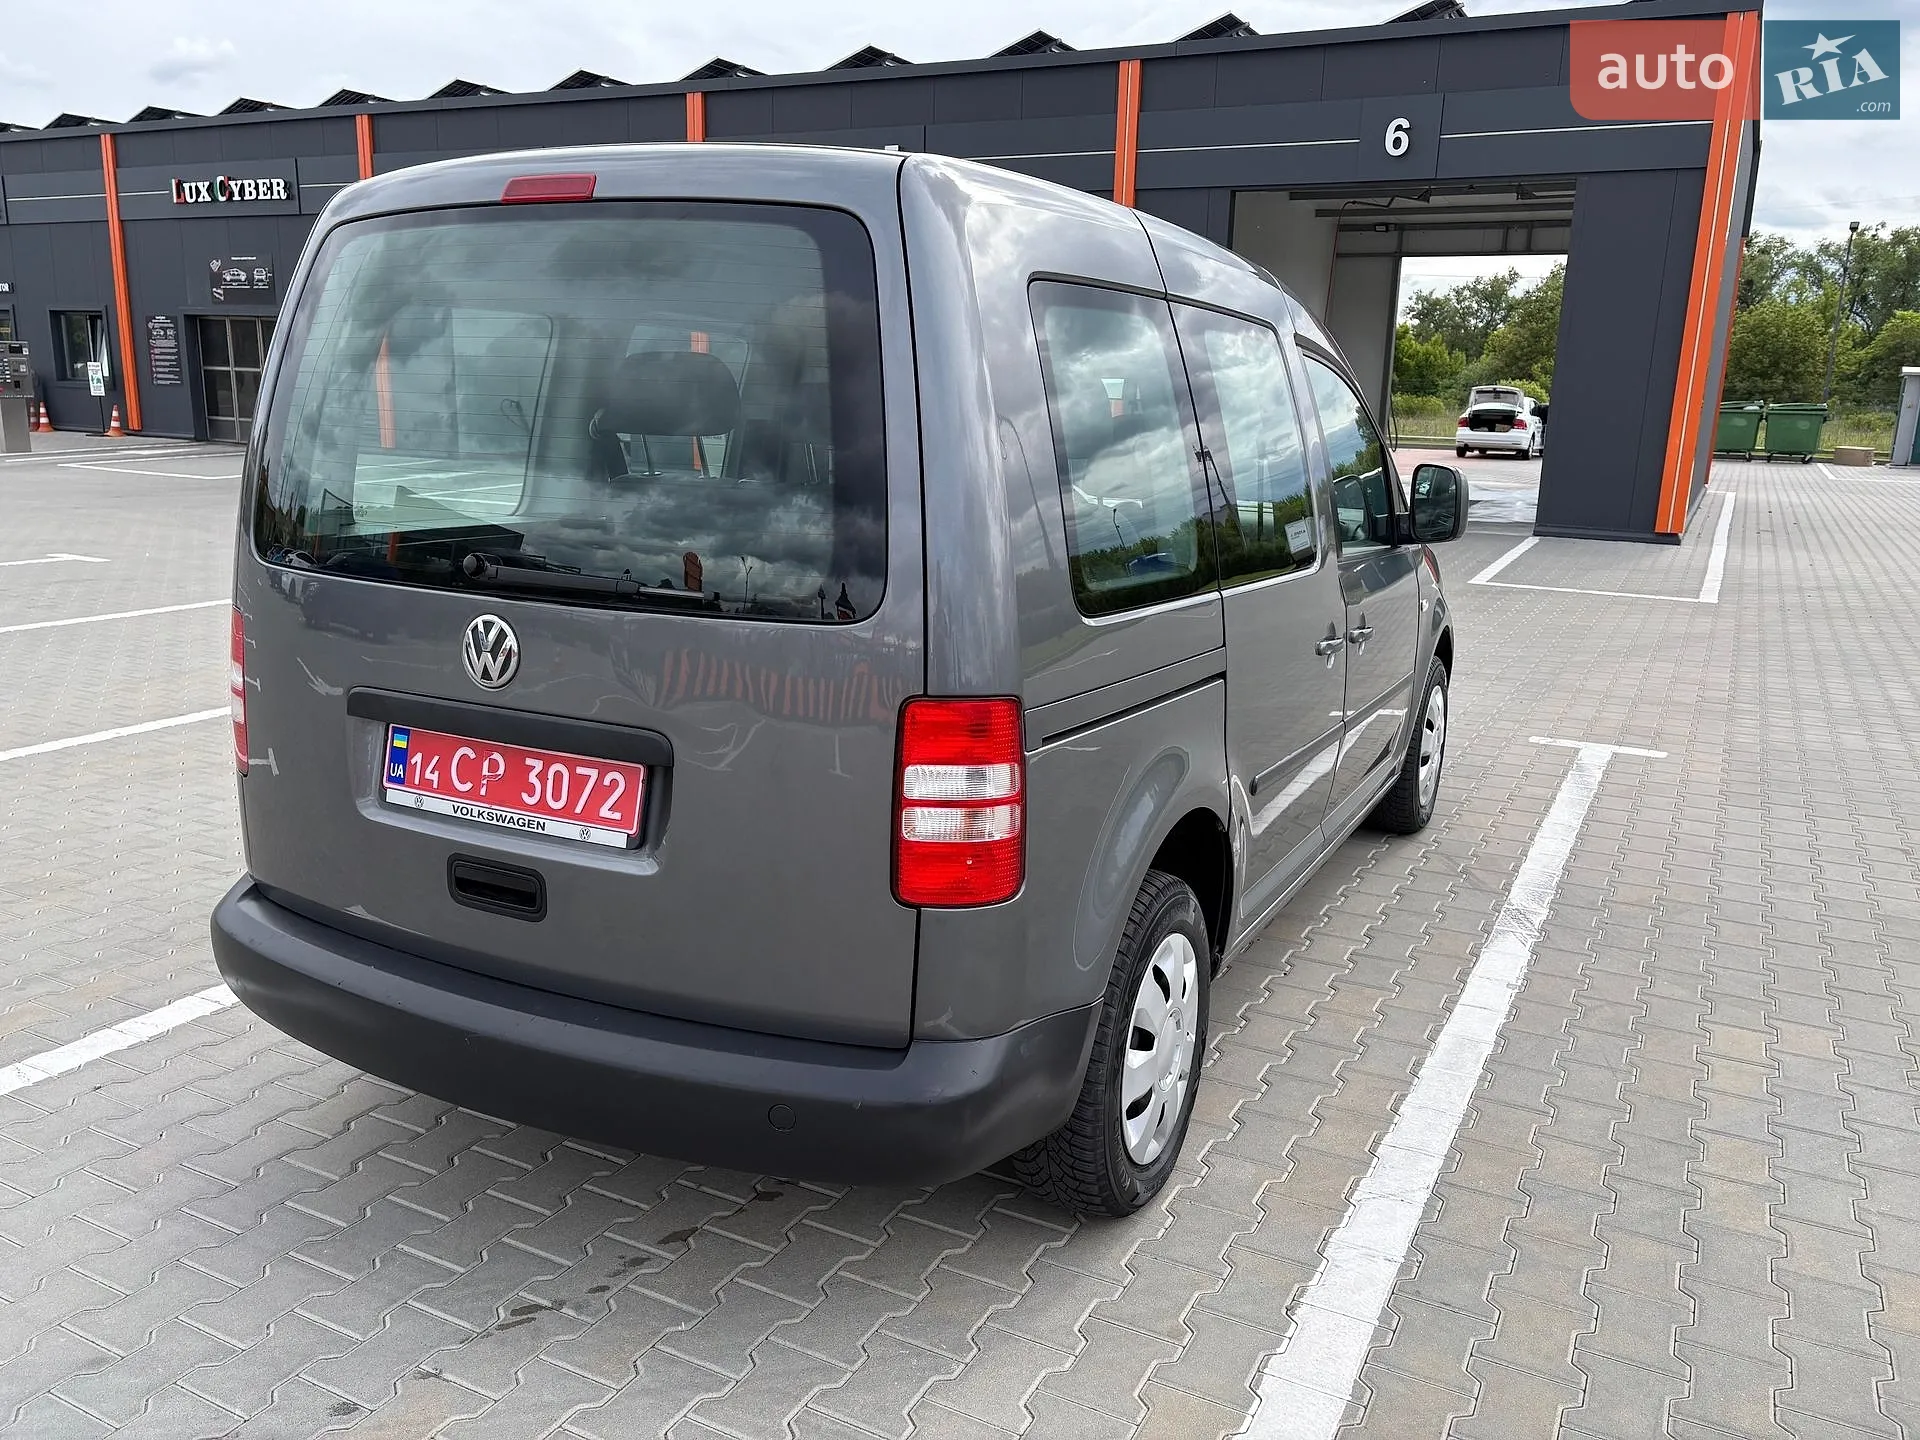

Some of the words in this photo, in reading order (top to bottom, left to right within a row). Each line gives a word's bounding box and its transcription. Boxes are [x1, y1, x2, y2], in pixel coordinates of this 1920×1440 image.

[1384, 118, 1409, 156] 6
[215, 175, 289, 202] CYBER
[390, 762, 404, 779] UA
[410, 752, 440, 789] 14
[520, 757, 626, 821] 3072
[451, 804, 547, 831] VOLKSWAGEN
